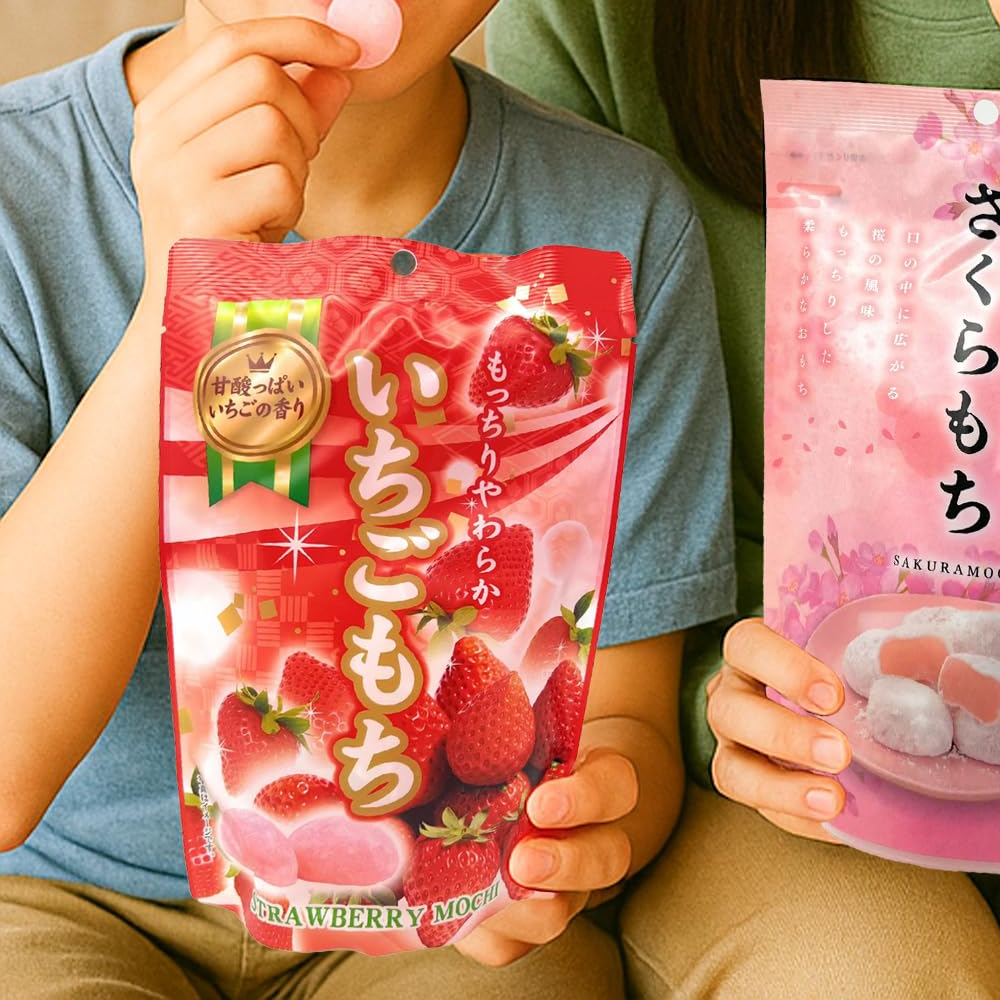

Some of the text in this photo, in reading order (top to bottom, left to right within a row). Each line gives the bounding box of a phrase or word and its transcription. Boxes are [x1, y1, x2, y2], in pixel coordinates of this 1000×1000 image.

[821, 224, 849, 364] もっちりした
[860, 228, 886, 318] 桜の風味
[888, 231, 920, 400] 口の中に広がる
[209, 397, 305, 420] いちごの香り
[211, 374, 305, 397] 甘酸っぱい
[471, 350, 509, 606] もっちりやわらか
[339, 353, 443, 811] いちごもち
[250, 883, 500, 929] STRAWBERRY MOCHI
